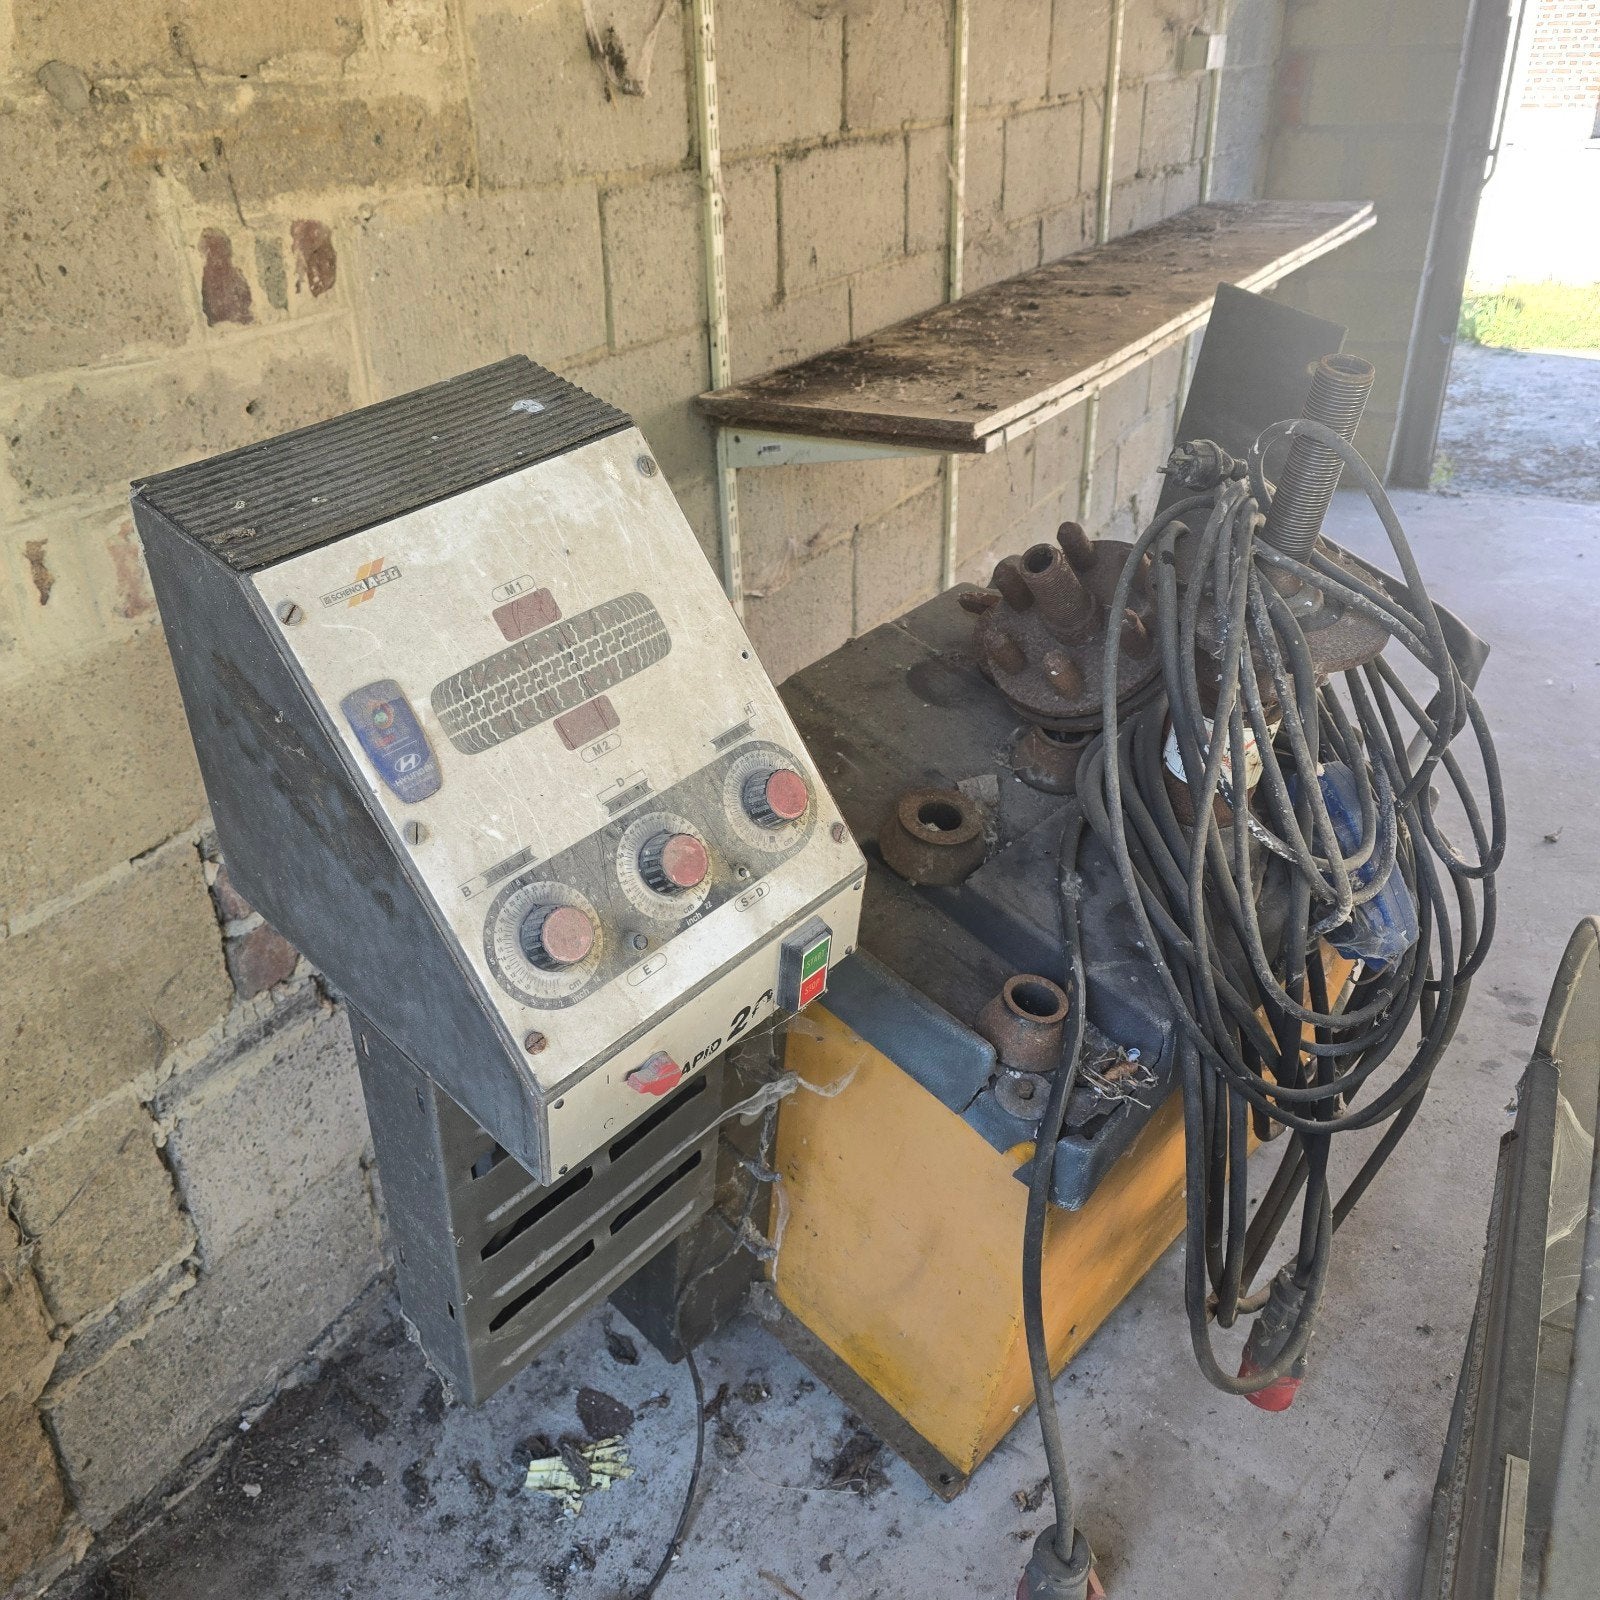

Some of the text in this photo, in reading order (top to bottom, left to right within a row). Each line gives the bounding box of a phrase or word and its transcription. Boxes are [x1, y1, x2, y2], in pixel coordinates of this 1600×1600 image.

[331, 583, 365, 602] SCHENCK
[394, 763, 435, 787] HYUNDAI
[616, 777, 625, 788] D
[783, 837, 794, 846] cm
[461, 886, 472, 898] B
[683, 903, 695, 914] cm
[685, 912, 703, 926] inch
[806, 949, 826, 969] START
[642, 964, 652, 976] E
[569, 980, 583, 991] cm
[804, 978, 821, 996] STOP
[571, 987, 590, 1004] inch
[681, 1037, 722, 1076] APID
